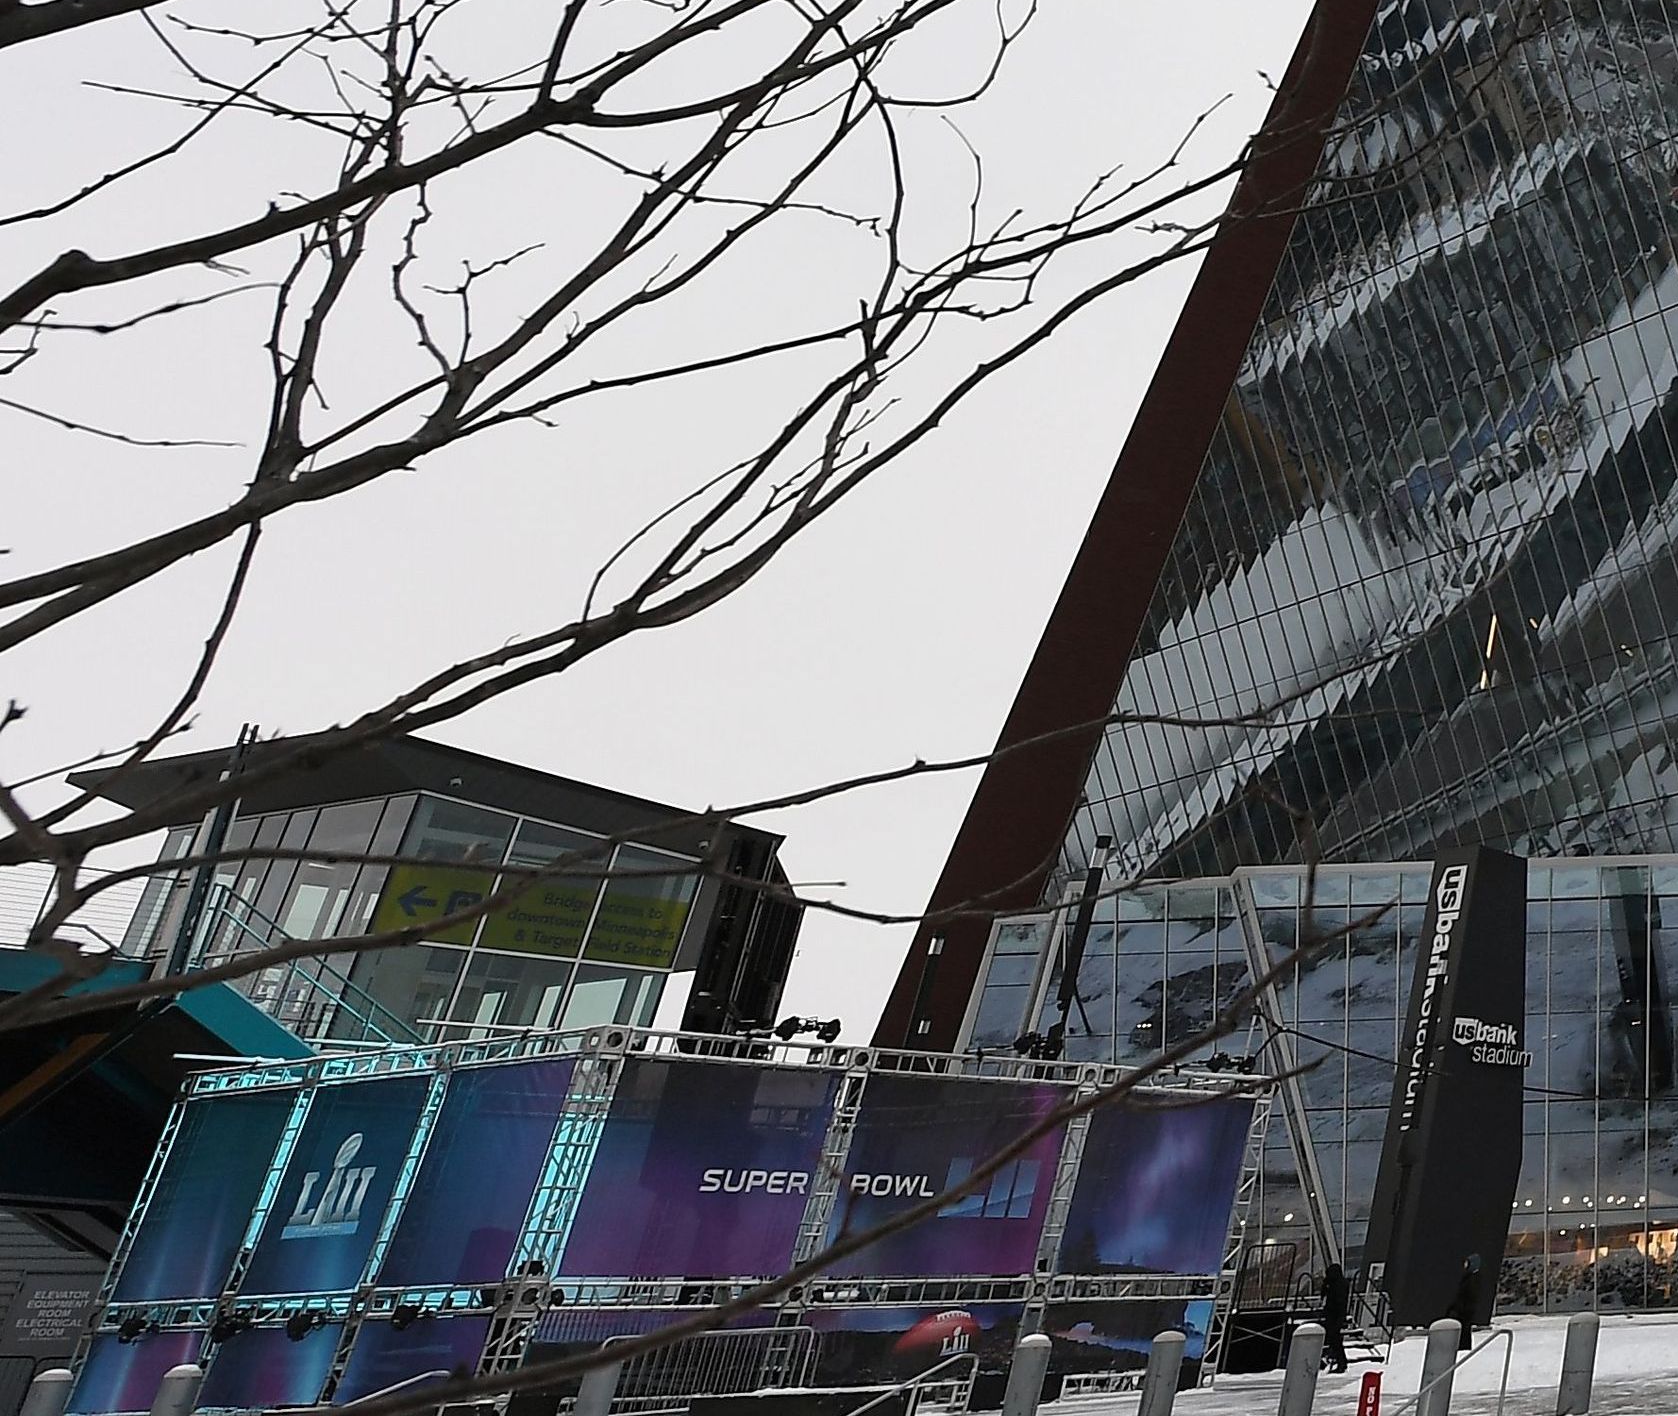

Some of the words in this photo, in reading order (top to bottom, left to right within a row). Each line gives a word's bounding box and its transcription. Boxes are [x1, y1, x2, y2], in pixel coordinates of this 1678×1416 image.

[507, 908, 585, 928] downtown
[623, 941, 672, 957] Station
[1471, 1043, 1534, 1067] stadium
[699, 1168, 809, 1195] SUPER
[850, 1173, 937, 1198] BOWL
[34, 1290, 90, 1299] ELEVATOR
[26, 1299, 90, 1309] EQUIPMENT
[37, 1309, 72, 1318] ROOM
[16, 1318, 83, 1328] ELECTRICAL
[30, 1328, 65, 1337] ROOM
